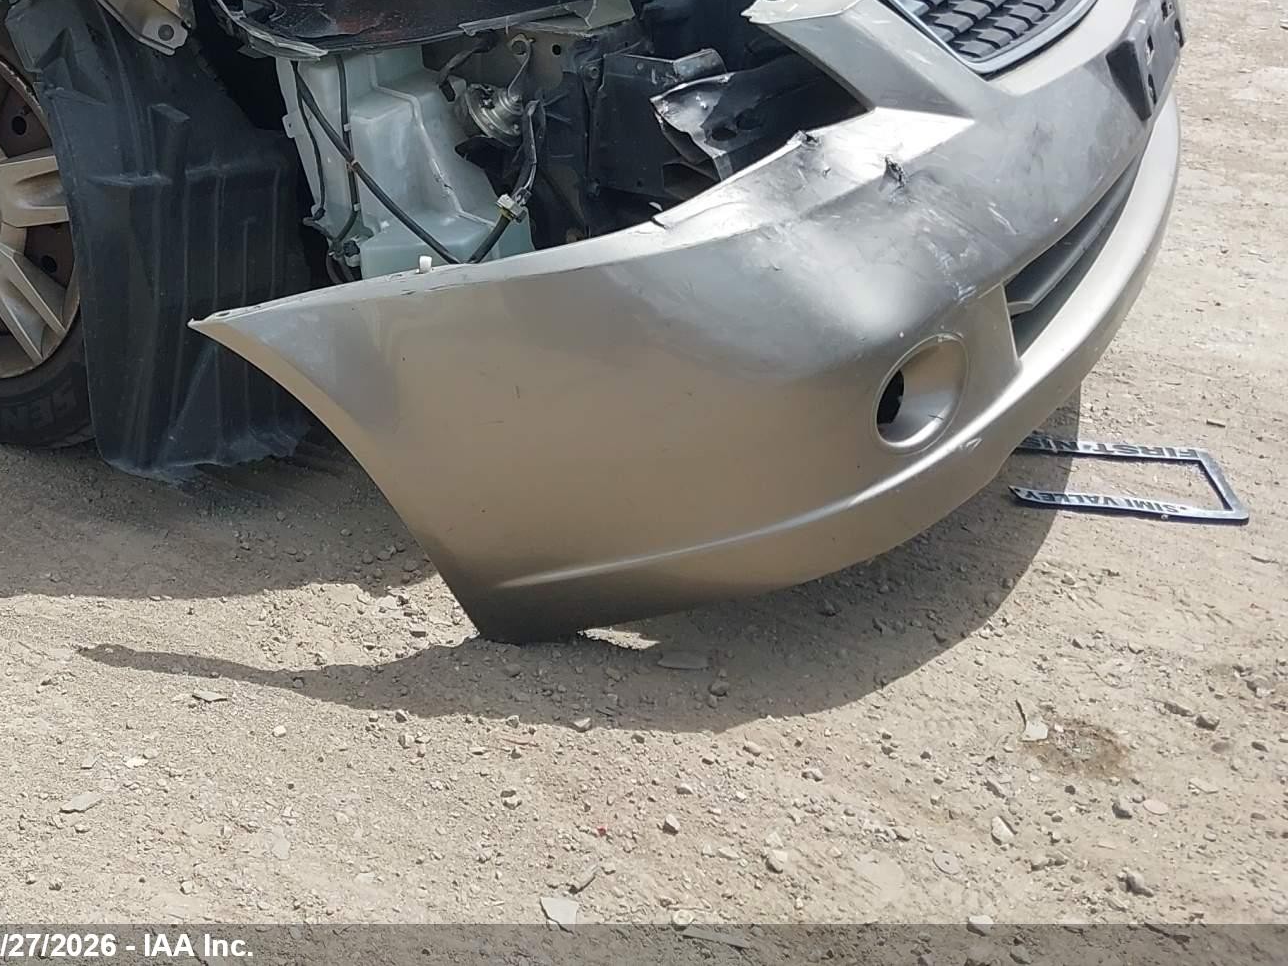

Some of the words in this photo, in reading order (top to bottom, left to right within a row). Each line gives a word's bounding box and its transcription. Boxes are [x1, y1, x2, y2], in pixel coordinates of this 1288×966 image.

[1092, 442, 1200, 459] FIRST
[1024, 490, 1120, 507] VALLEY
[1123, 497, 1180, 513] SIMI
